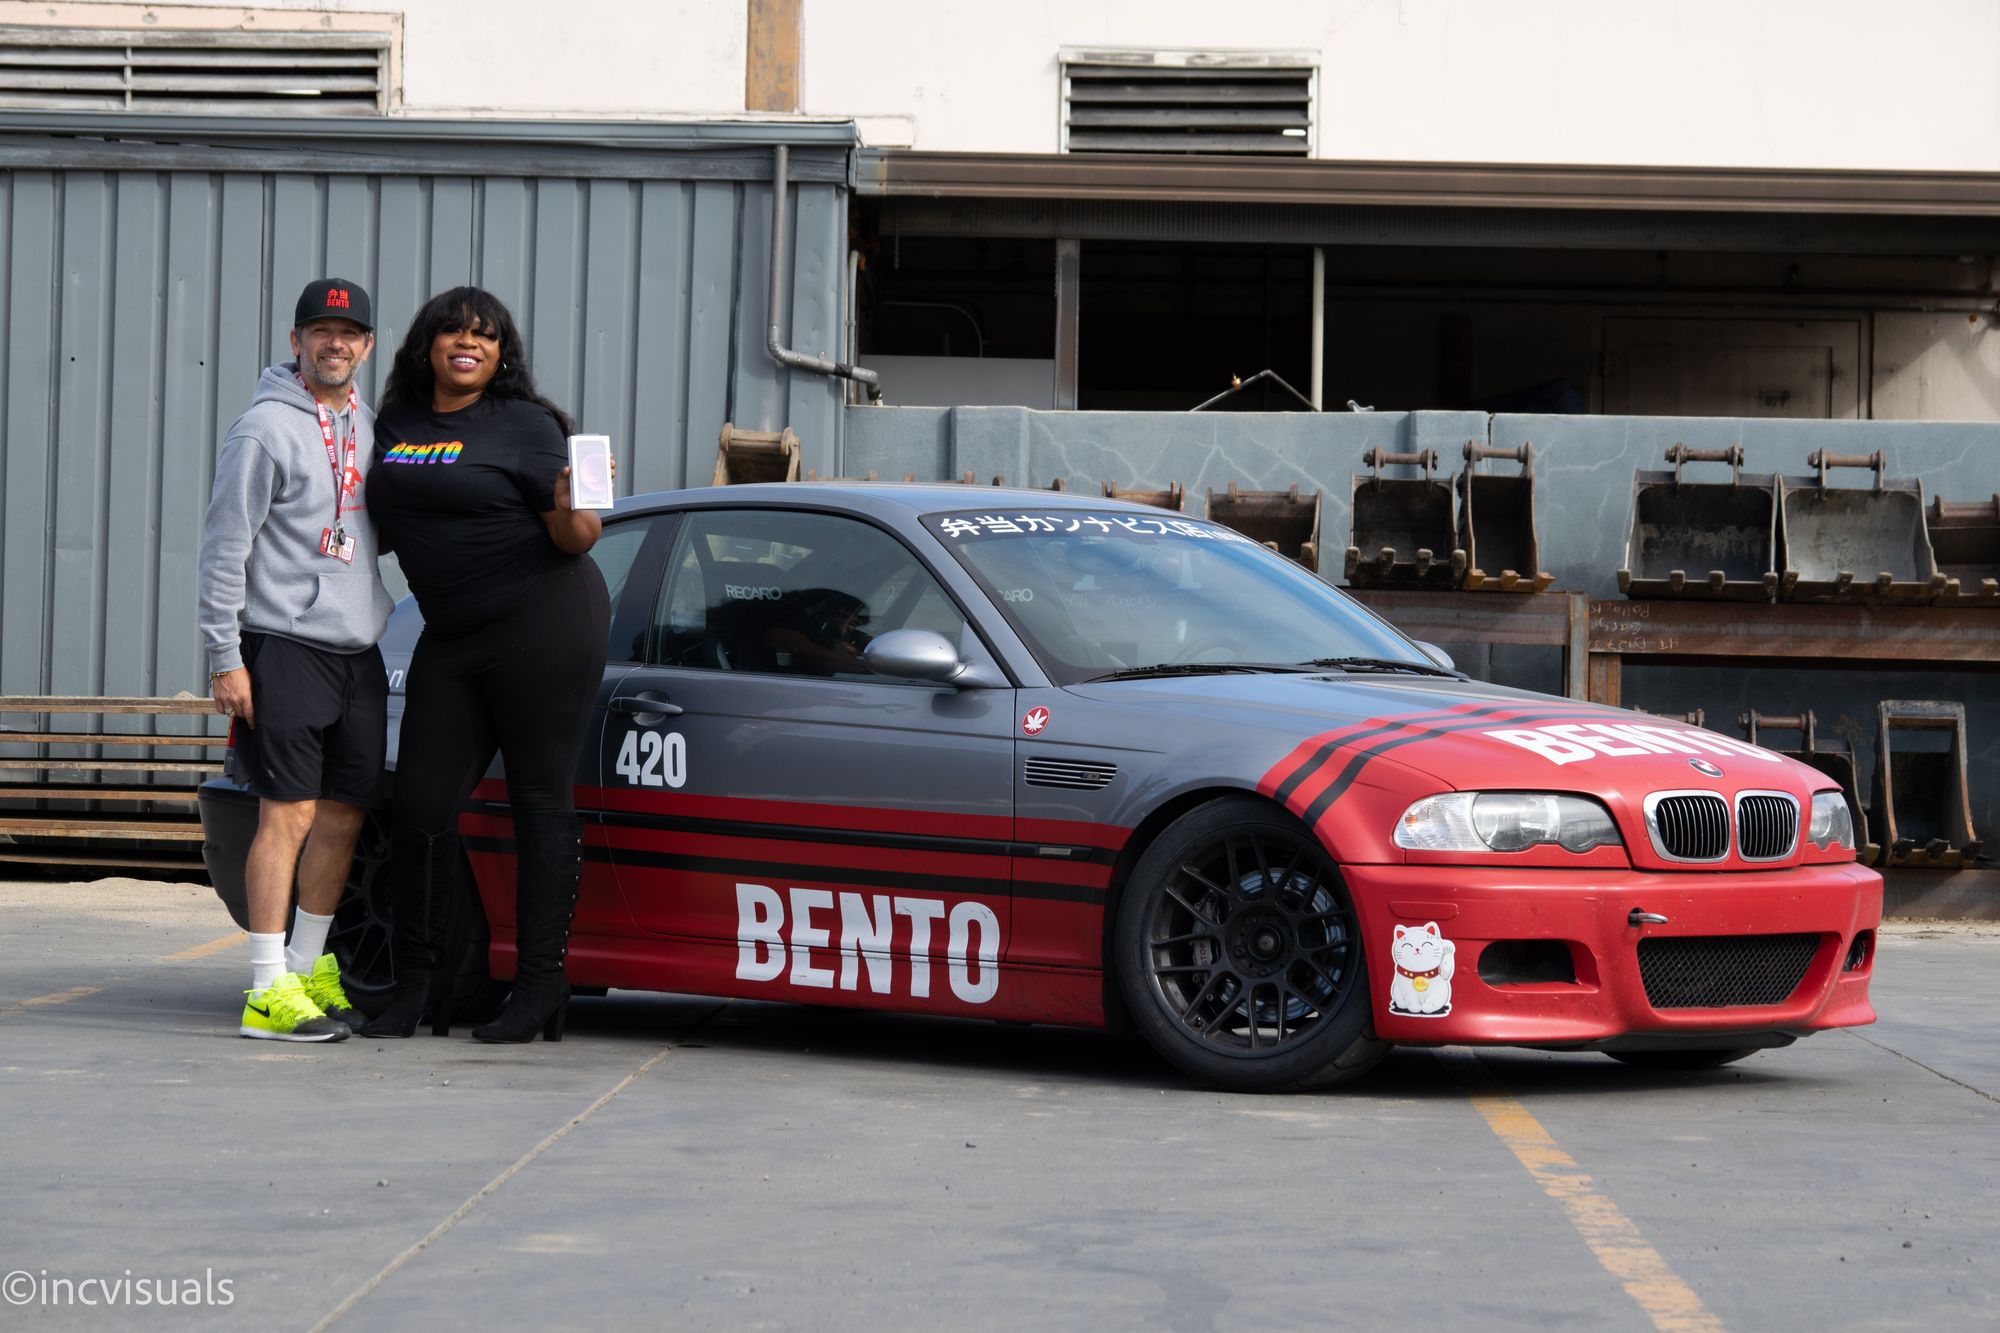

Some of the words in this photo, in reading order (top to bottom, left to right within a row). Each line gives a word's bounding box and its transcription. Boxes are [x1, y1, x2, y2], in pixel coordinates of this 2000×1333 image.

[326, 299, 349, 308] BENTO
[327, 288, 349, 300] 弁当
[383, 441, 464, 465] BENTO
[725, 584, 782, 600] RECARO
[998, 588, 1034, 602] ARO
[1482, 724, 1783, 766] BENTO
[616, 730, 687, 788] 420
[736, 883, 1000, 1004] BENTO
